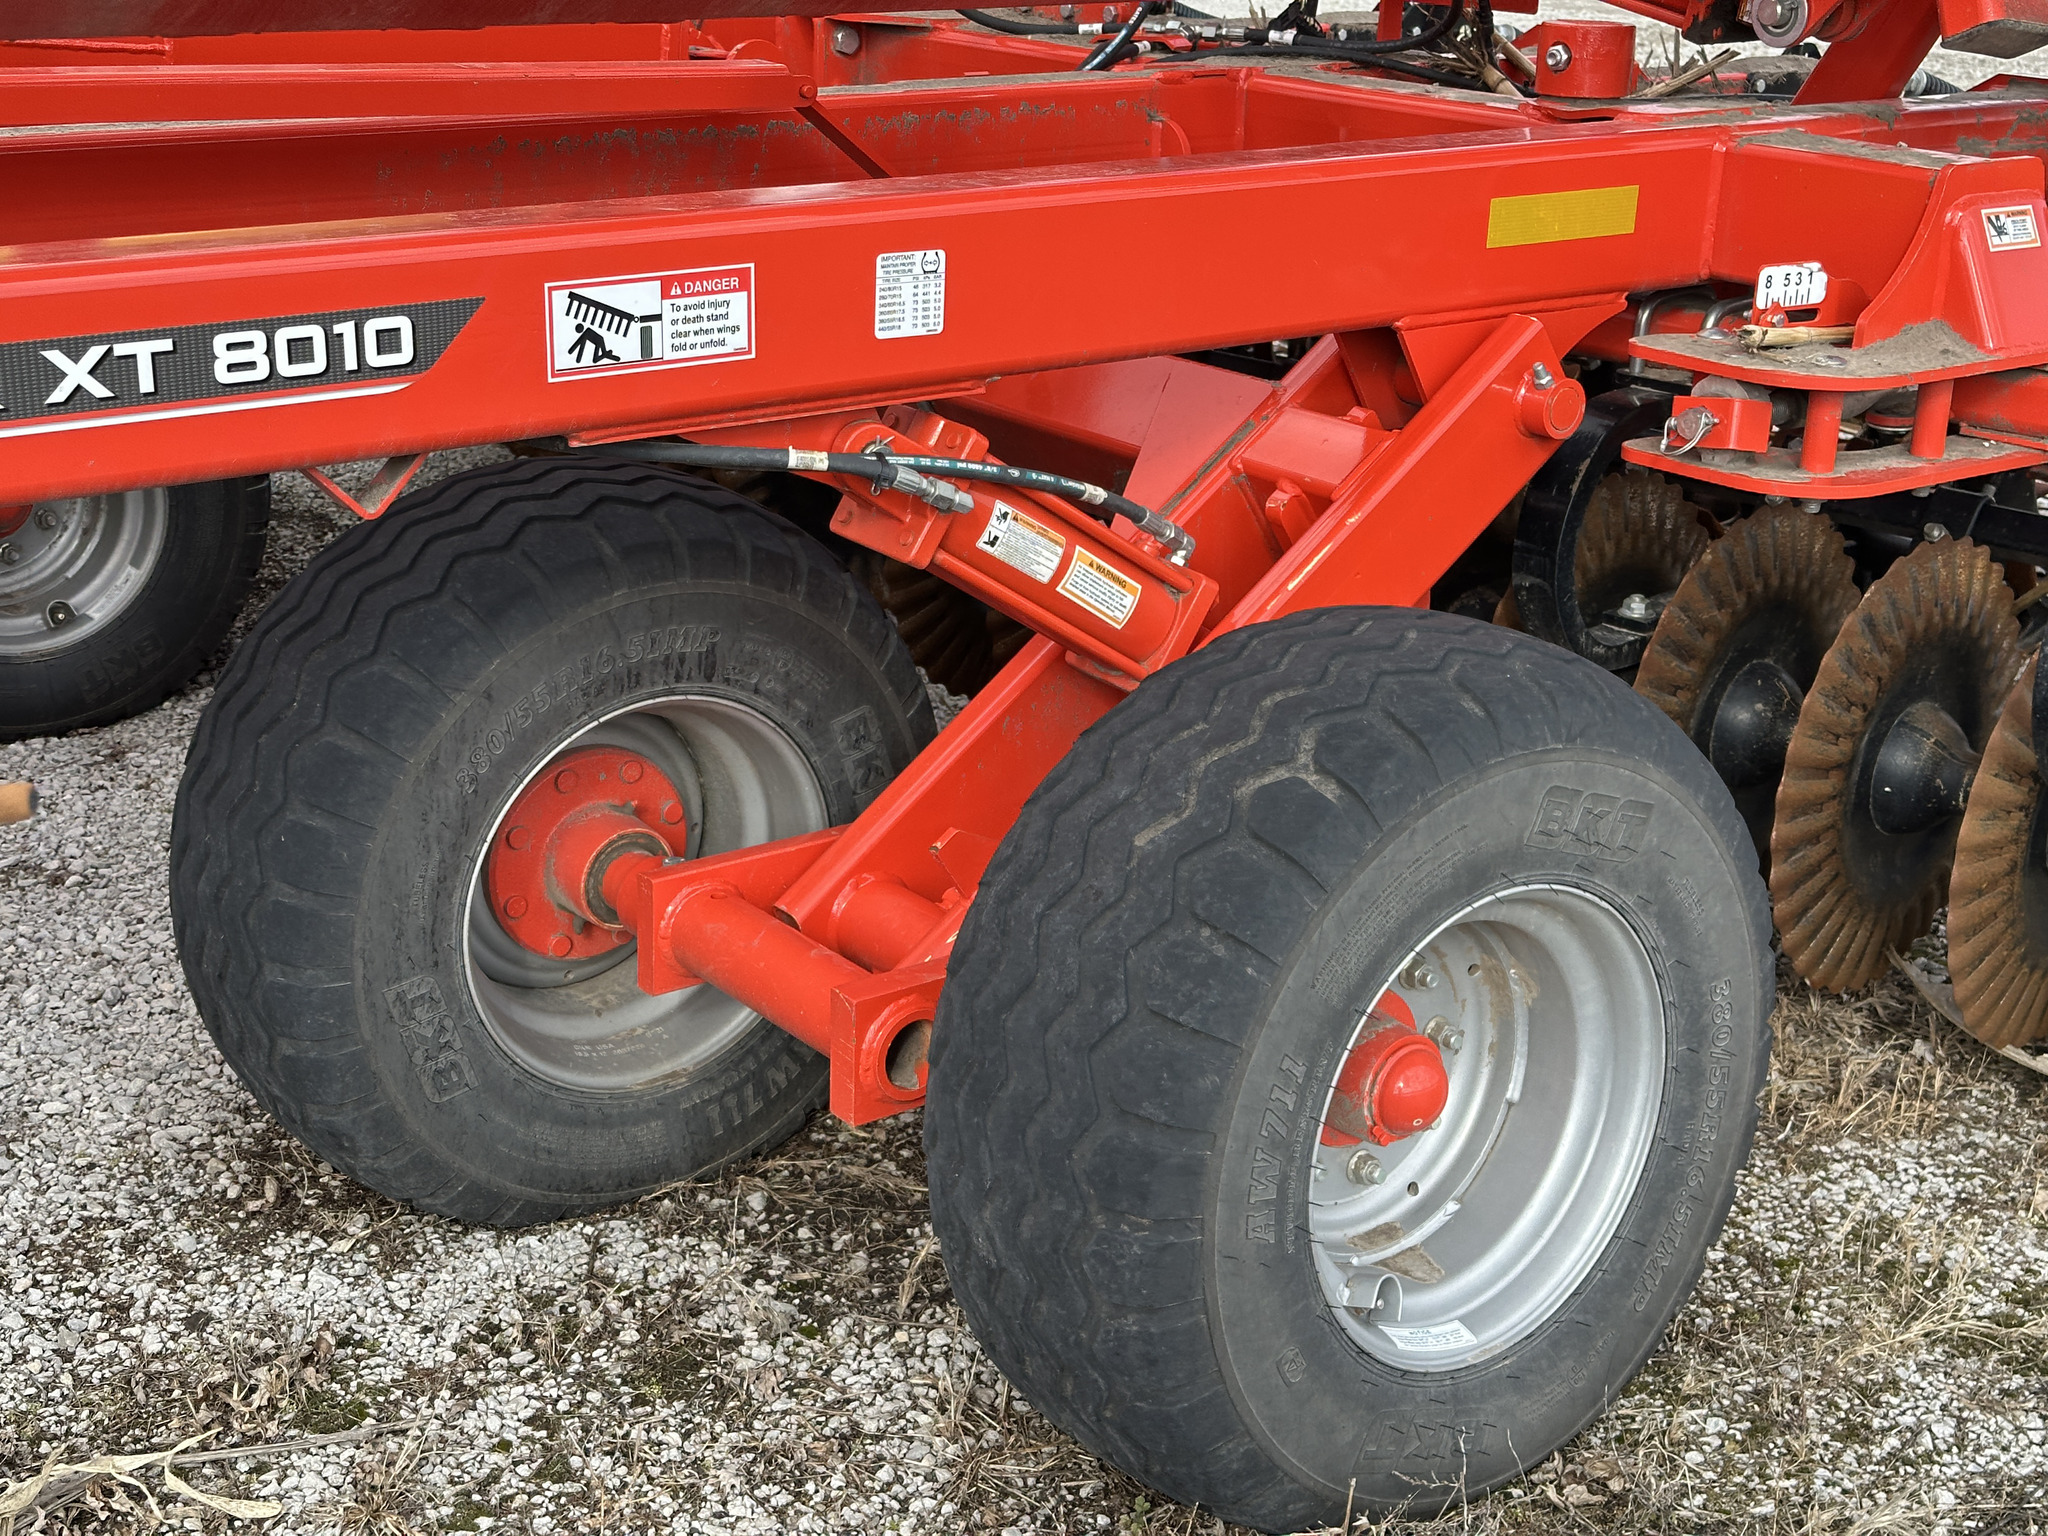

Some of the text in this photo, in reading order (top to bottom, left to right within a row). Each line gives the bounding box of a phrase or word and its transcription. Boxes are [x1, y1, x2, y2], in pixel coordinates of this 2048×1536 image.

[685, 277, 739, 294] DANGER
[1765, 274, 1773, 289] 8
[670, 299, 731, 312] To avoid injury
[682, 314, 704, 325] death
[706, 311, 729, 322] stand
[671, 324, 740, 339] clear when wings
[671, 342, 686, 352] fold
[700, 338, 728, 349] unfold.
[39, 316, 414, 404] XT 8010
[1092, 562, 1129, 589] WARNING
[1526, 786, 1654, 862] BKT
[383, 976, 479, 1103] BKT
[706, 1082, 764, 1136] 711
[1246, 1054, 1308, 1244] AW 711
[1633, 978, 1732, 1312] 380/55R16.5IMP
[1674, 1119, 1696, 1168] RADIAL
